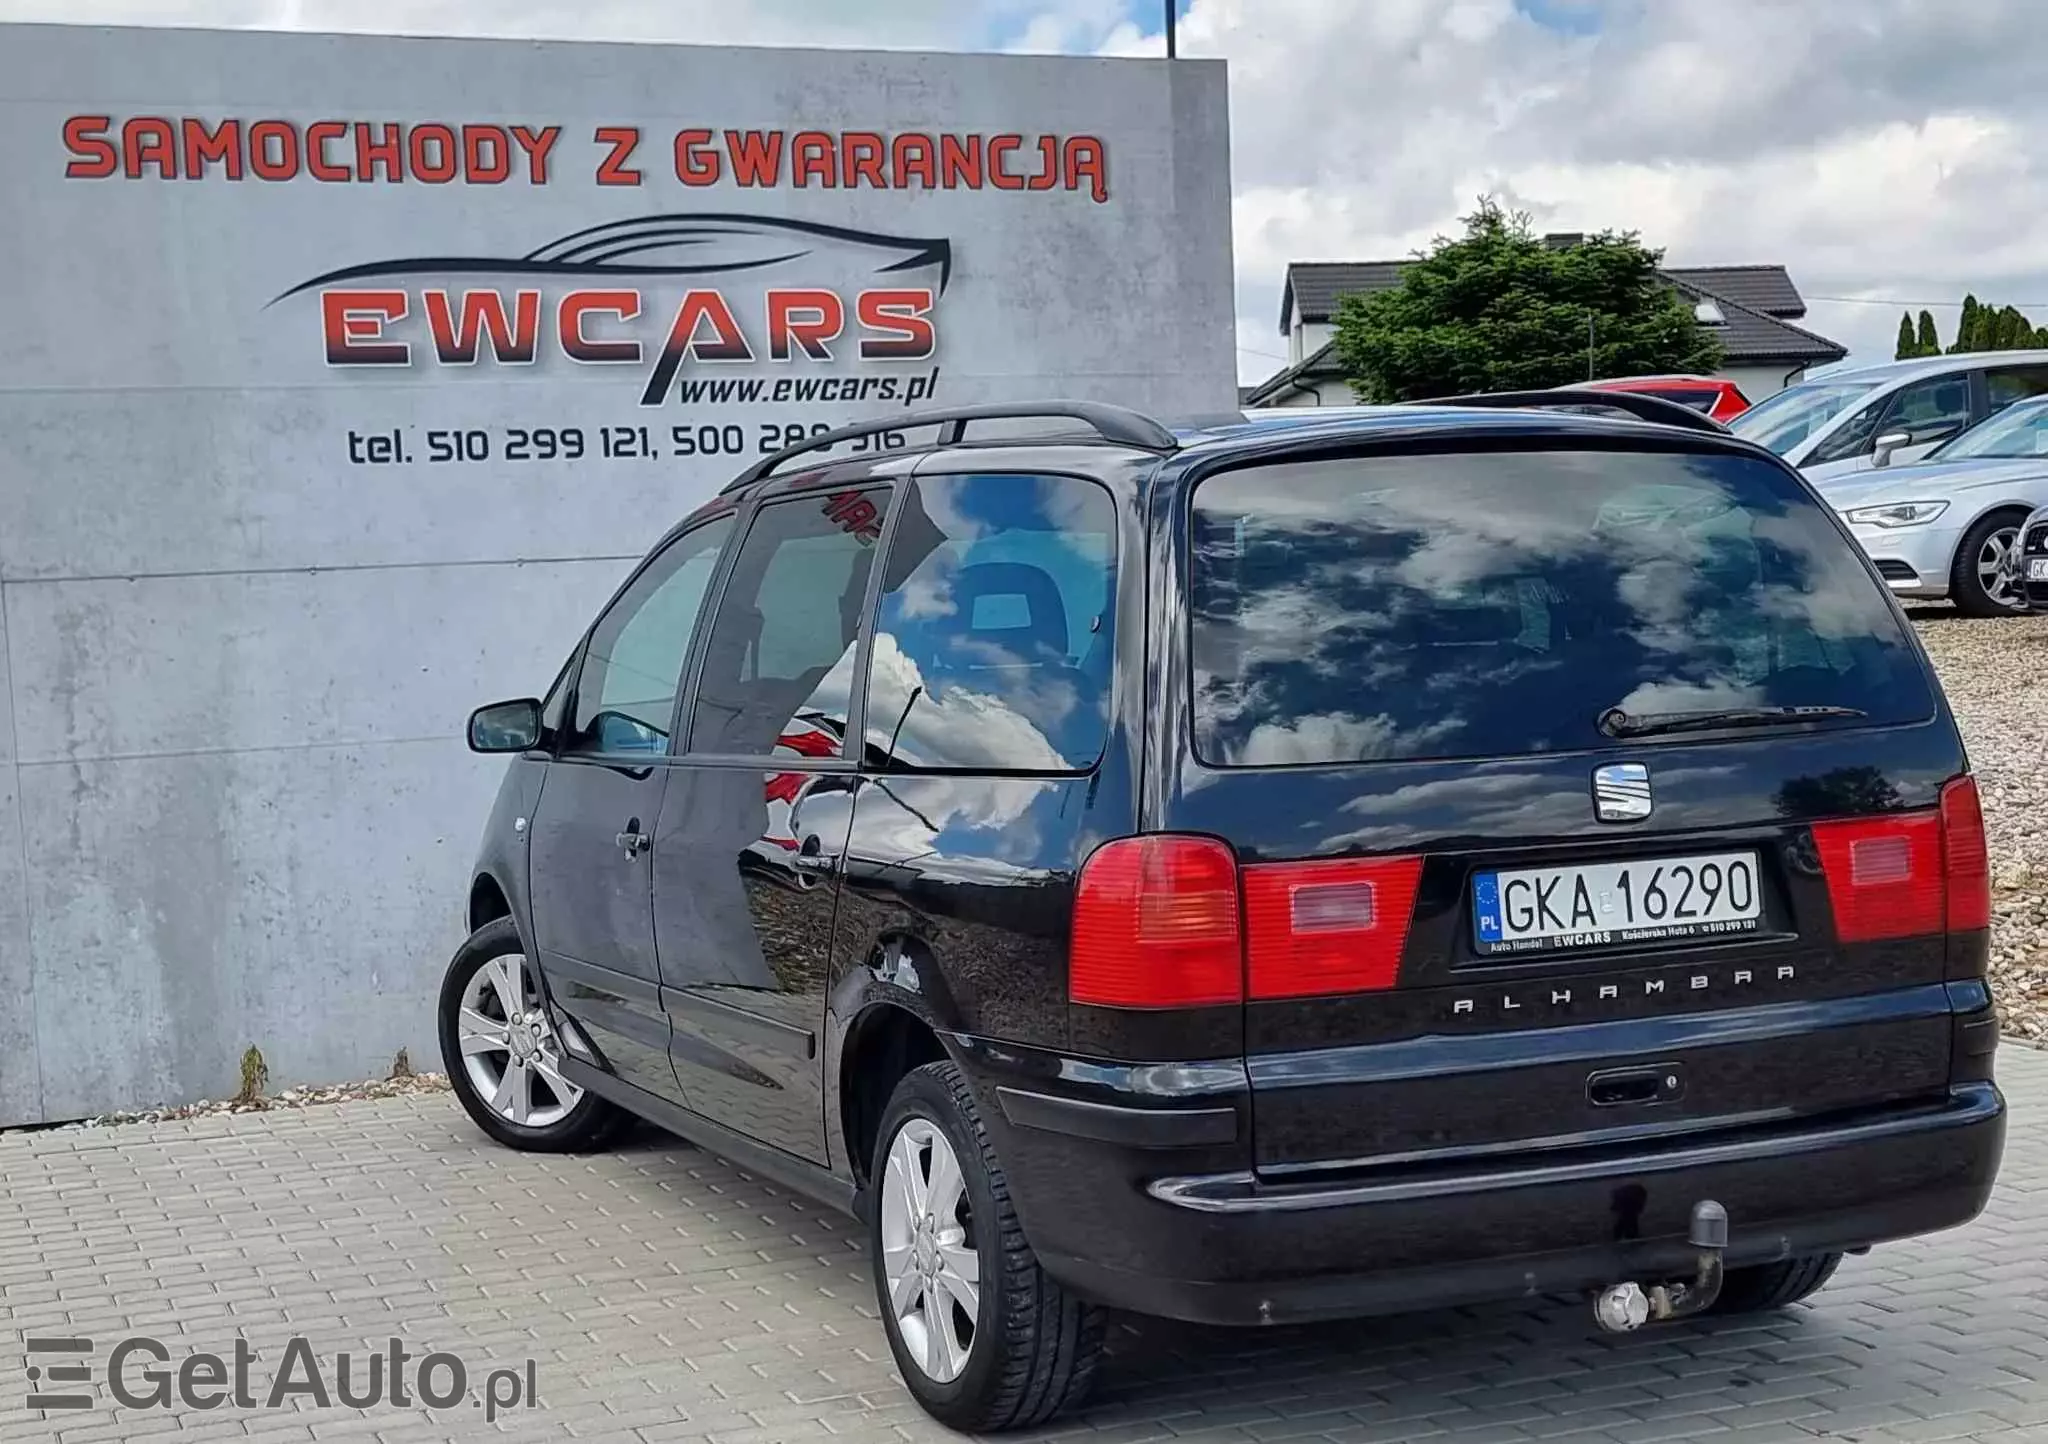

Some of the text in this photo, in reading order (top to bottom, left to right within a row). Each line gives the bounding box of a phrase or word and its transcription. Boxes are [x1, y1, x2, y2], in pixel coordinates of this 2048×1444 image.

[63, 115, 1108, 203] SAMOCHODY Z GWARANCJĄ
[320, 288, 936, 405] EWCARS
[680, 366, 939, 406] www.ewcars.pl
[348, 429, 413, 463] tel.
[427, 430, 489, 462] 510
[505, 428, 584, 460] 299
[600, 426, 658, 460] 121,
[672, 425, 744, 455] 500
[1504, 860, 1753, 933] GKA 16290
[1480, 915, 1499, 932] PL
[1553, 931, 1612, 948] EWCARS
[1452, 965, 1795, 1014] ALHAMBRA
